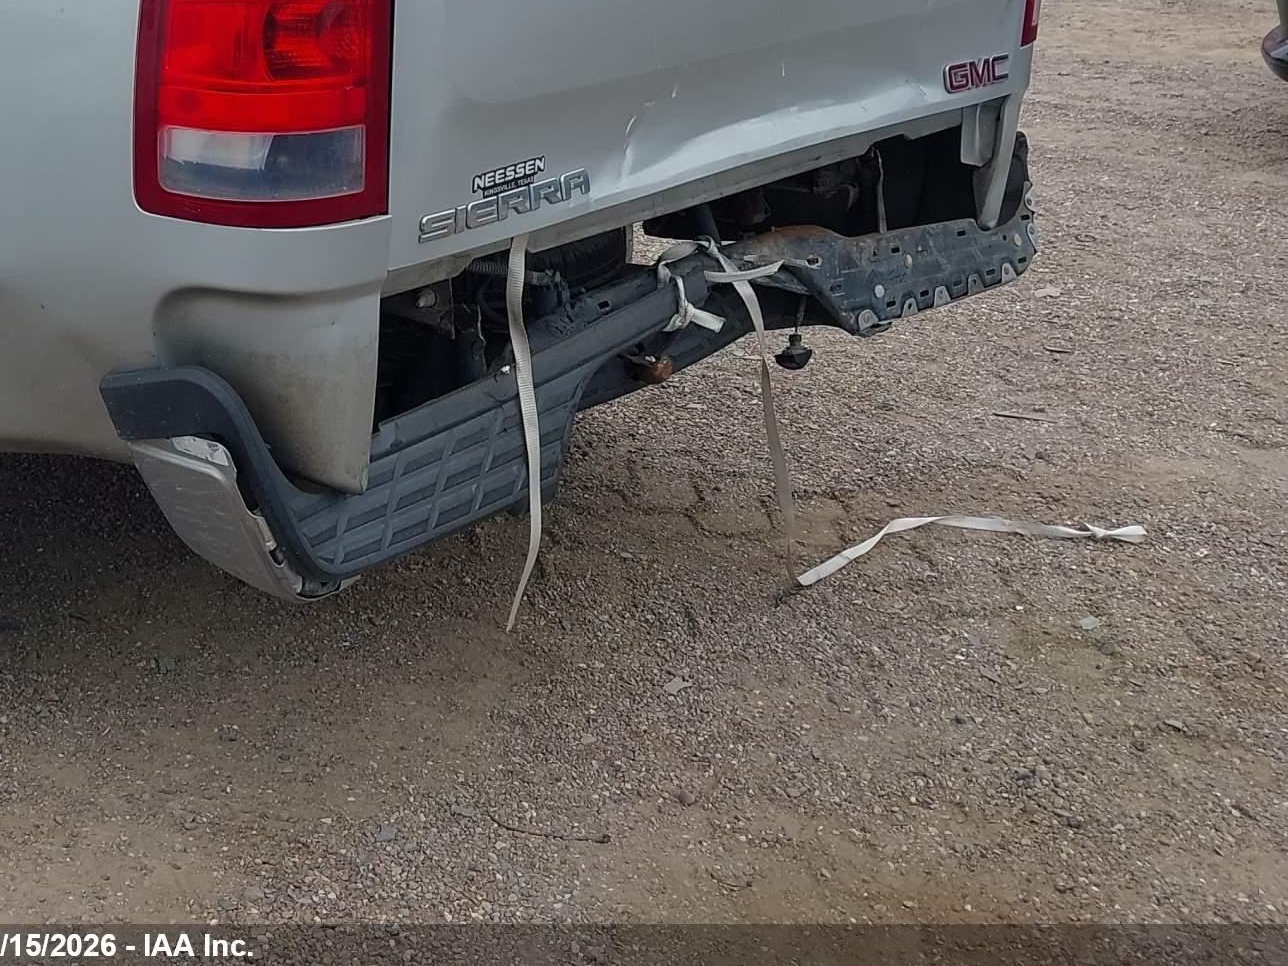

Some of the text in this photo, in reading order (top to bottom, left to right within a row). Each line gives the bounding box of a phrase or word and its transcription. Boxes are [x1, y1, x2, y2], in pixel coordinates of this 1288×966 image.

[943, 52, 1009, 94] GMC
[473, 156, 545, 192] NEESSEN
[517, 176, 534, 186] TEXAS
[418, 167, 591, 244] SIERRA
